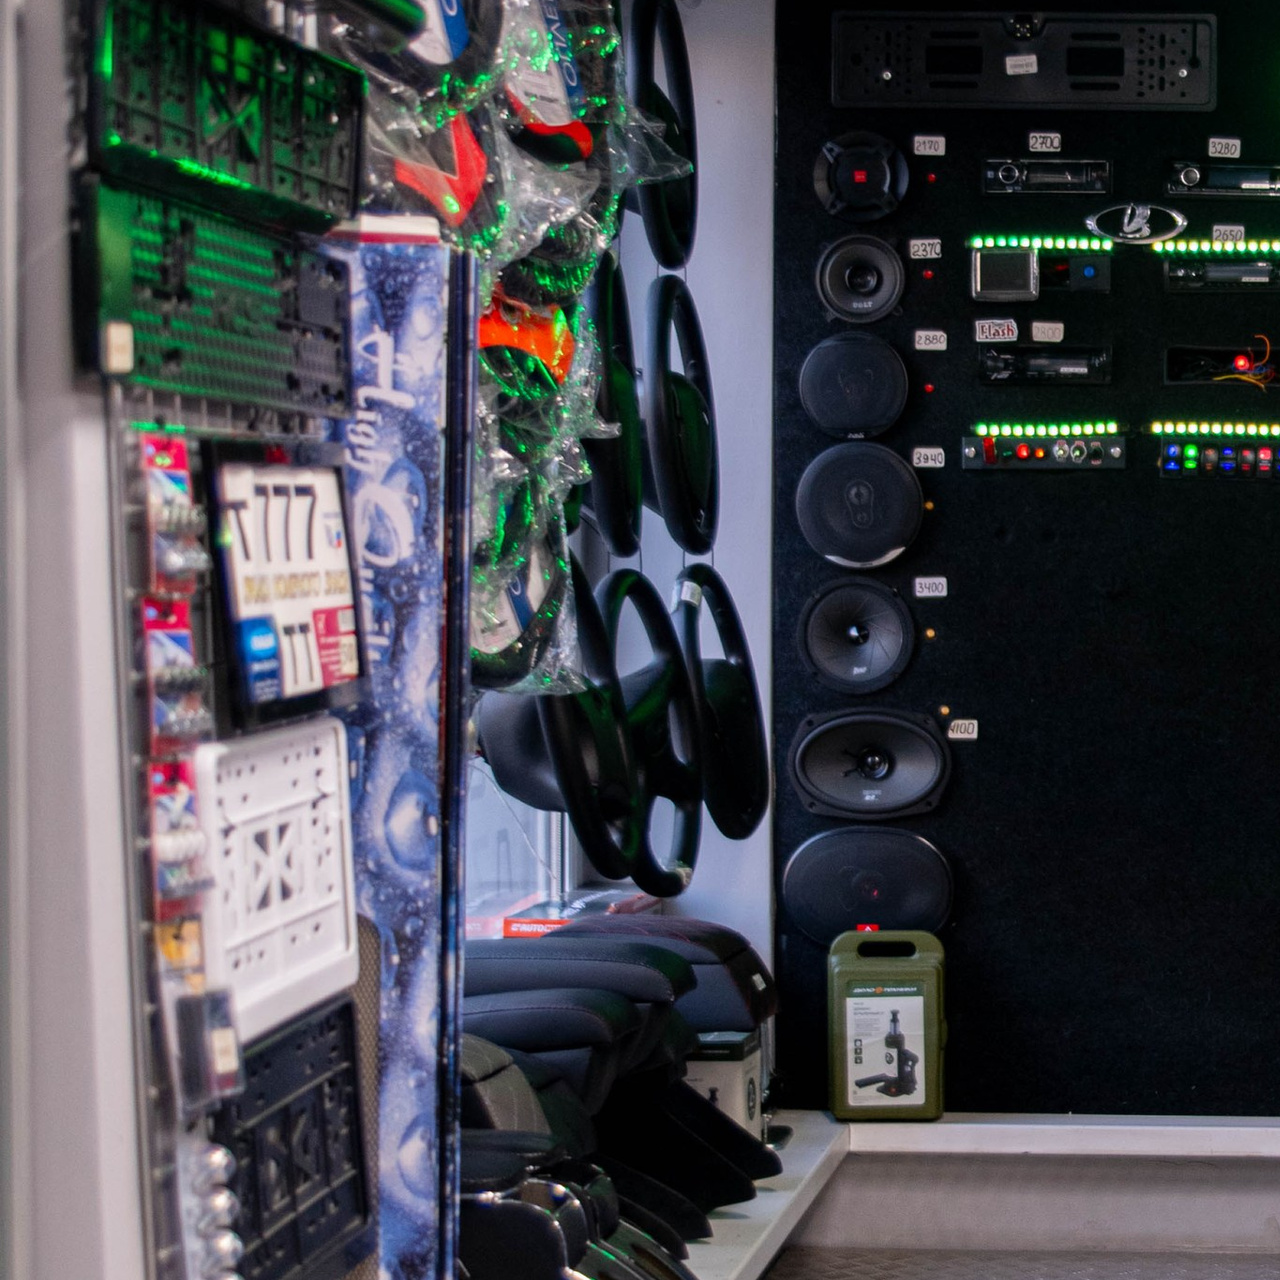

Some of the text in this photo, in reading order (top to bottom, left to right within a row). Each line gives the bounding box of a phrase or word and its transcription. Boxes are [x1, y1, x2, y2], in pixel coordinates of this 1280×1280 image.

[1030, 134, 1061, 150] 2700
[1210, 141, 1237, 156] 3280
[1214, 228, 1244, 242] 2650
[912, 243, 941, 258] 2370
[981, 324, 1015, 339] Flash
[917, 334, 945, 345] 2880
[914, 450, 943, 464] 3940
[917, 581, 944, 594] 3400
